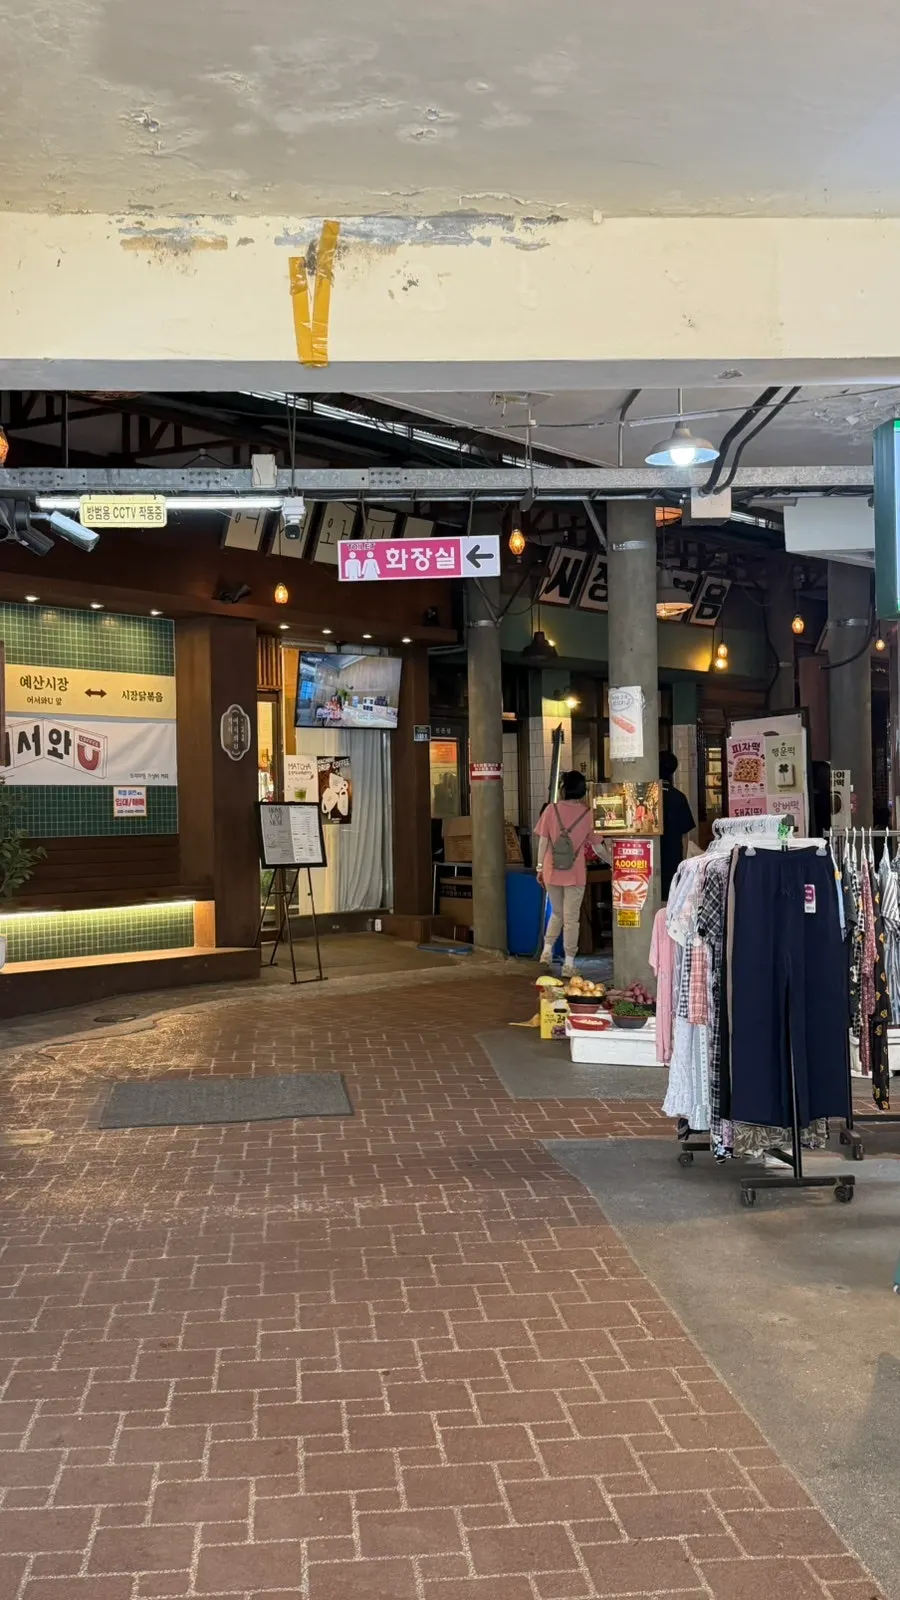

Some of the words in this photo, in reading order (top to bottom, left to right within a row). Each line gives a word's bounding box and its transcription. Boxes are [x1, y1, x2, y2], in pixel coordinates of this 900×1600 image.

[86, 505, 110, 521] 방범용
[113, 506, 136, 519] CCTV
[139, 505, 163, 521] 작동중
[346, 542, 377, 551] TOILET
[385, 546, 456, 572] 화장실
[19, 674, 69, 693] 예산시장
[121, 689, 164, 703] 시장닭볶음
[731, 741, 761, 754] 피자떡
[771, 746, 796, 758] 행운떡
[287, 762, 312, 771] MATCHA
[614, 859, 648, 870] 4,000원!
